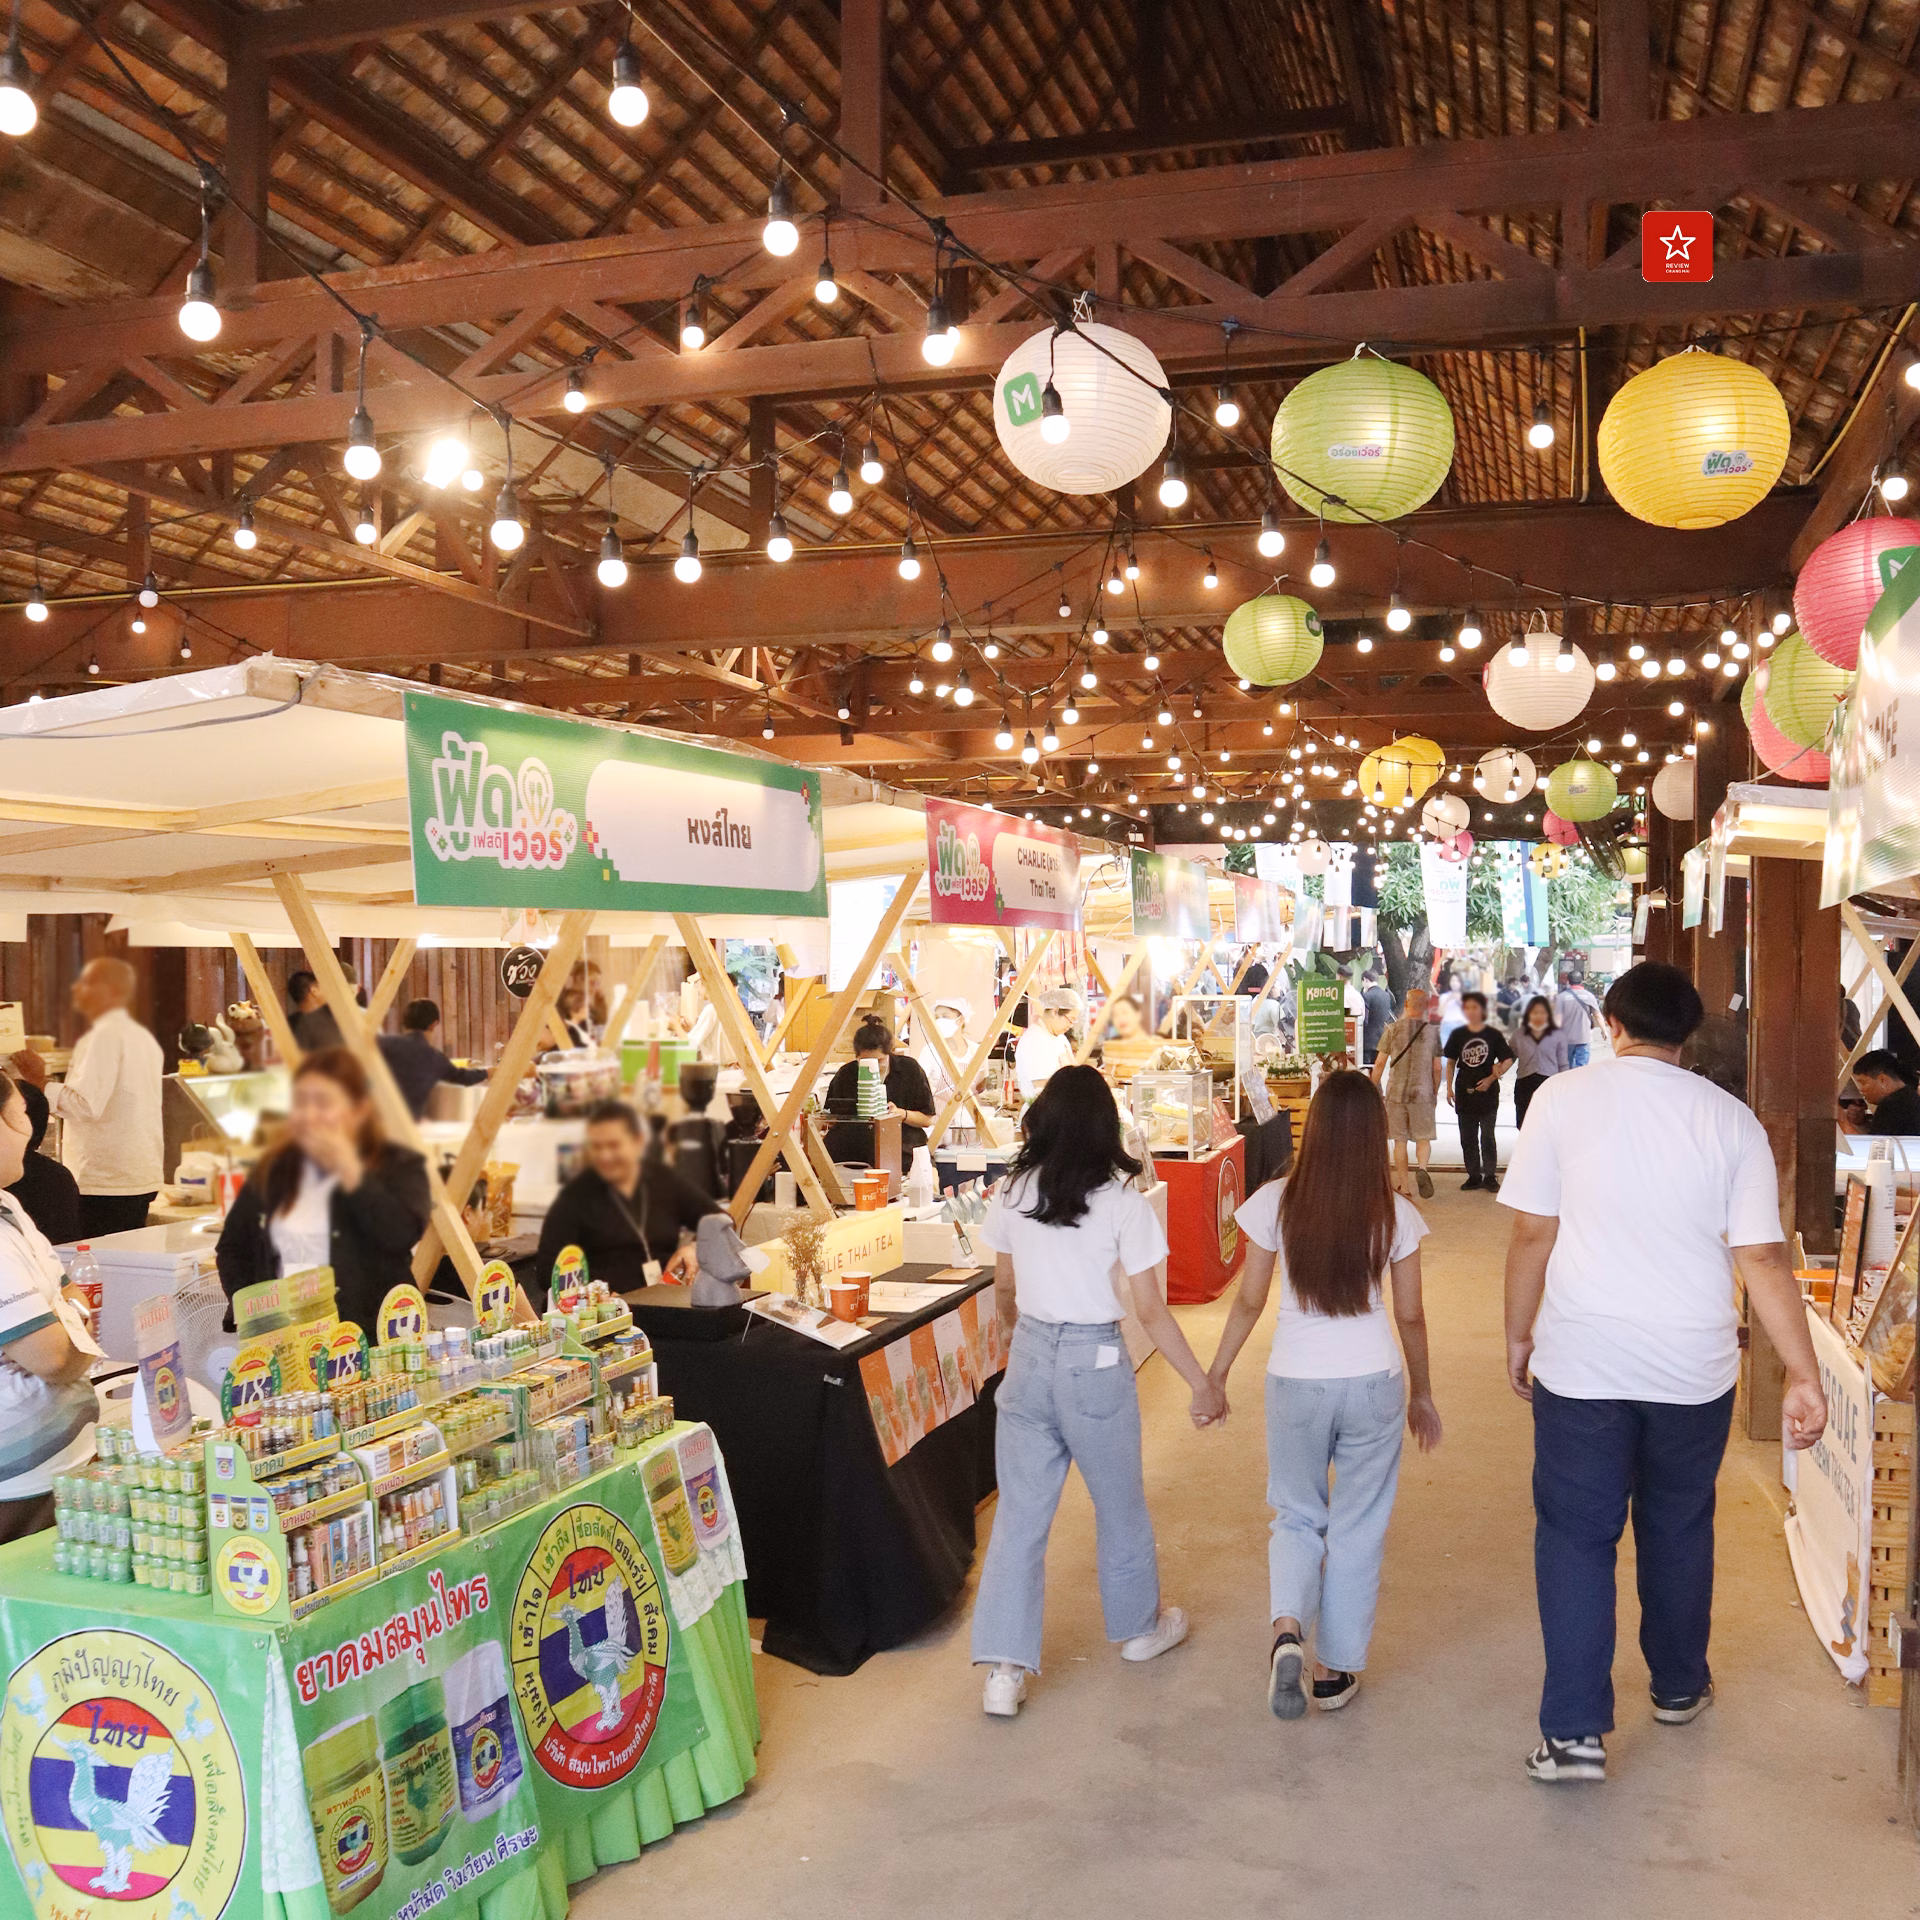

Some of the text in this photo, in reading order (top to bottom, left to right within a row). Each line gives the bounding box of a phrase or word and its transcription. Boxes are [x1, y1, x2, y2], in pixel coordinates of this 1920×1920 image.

[1331, 446, 1382, 457] อร่อยเว่อร์
[437, 740, 513, 852] ฟู้ด
[687, 808, 752, 850] หงส์ไทย
[1017, 847, 1046, 871] CHARLIE
[1030, 879, 1056, 900] Thai Tea
[1306, 986, 1339, 1001] หยกสด
[848, 1241, 871, 1265] THAI
[875, 1234, 893, 1252] TEA
[331, 1346, 357, 1388] 18
[238, 1372, 266, 1416] 18
[348, 1426, 376, 1447] ยาดม
[254, 1454, 284, 1477] ยาดม
[282, 1507, 316, 1530] ยาหม่อง
[542, 1528, 570, 1575] เข้าถึง
[615, 1538, 648, 1592] ยอมรับ
[565, 1562, 606, 1600] ไทย
[296, 1571, 490, 1703] ยาดมสมุนไพร
[518, 1587, 543, 1648] เข้าใจ
[643, 1602, 660, 1656] สังคม
[52, 1649, 180, 1707] ภูมิปัญญาไทย
[523, 1671, 549, 1728] มุ่งมั่น
[85, 1703, 150, 1750] ไทย
[544, 1736, 567, 1768] บริษัท
[397, 1827, 539, 1919] หน้ามืด วิงเวียน ศีรษะ
